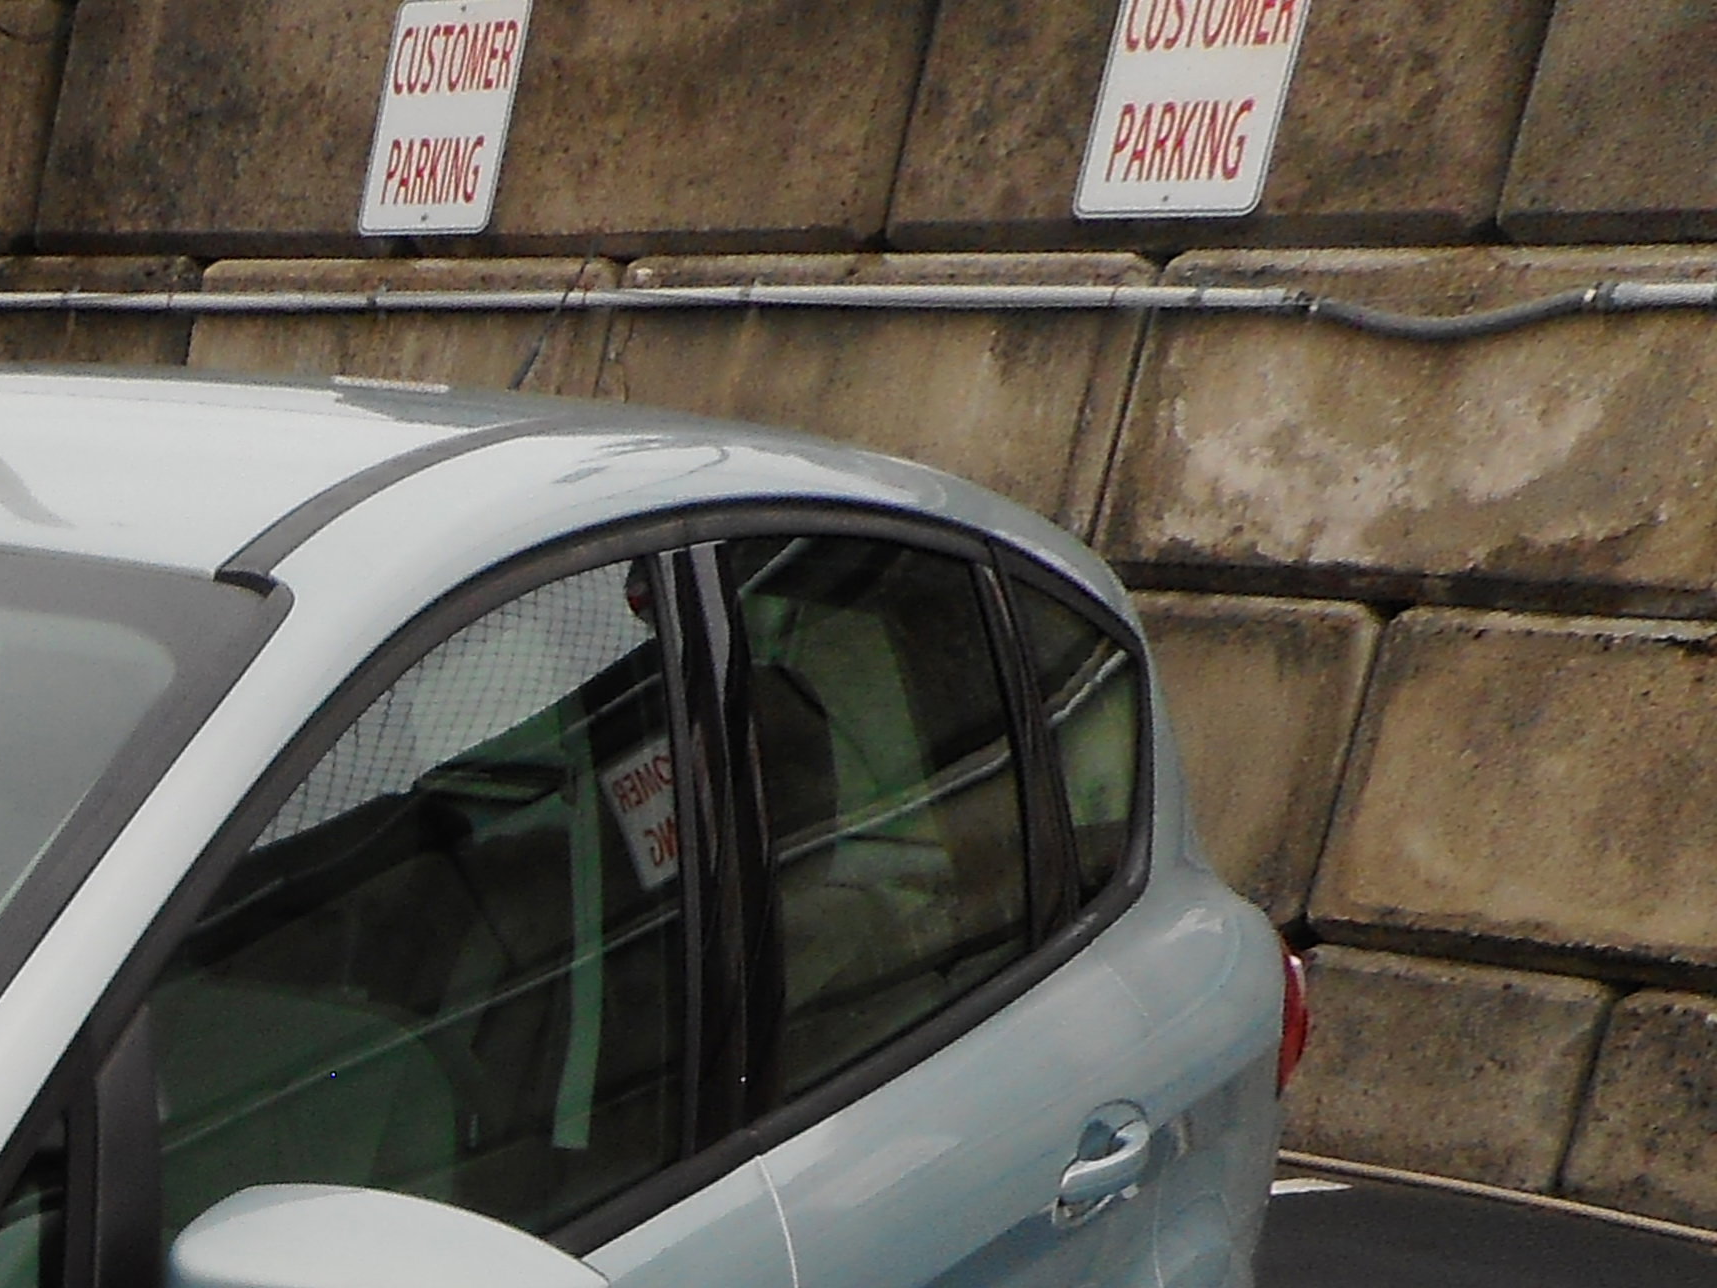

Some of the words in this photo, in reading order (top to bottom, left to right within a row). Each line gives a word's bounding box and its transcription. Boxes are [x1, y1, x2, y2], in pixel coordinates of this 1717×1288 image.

[393, 20, 519, 95] CUSTOMER
[380, 135, 485, 206] PARKING
[1105, 98, 1255, 182] PARKING
